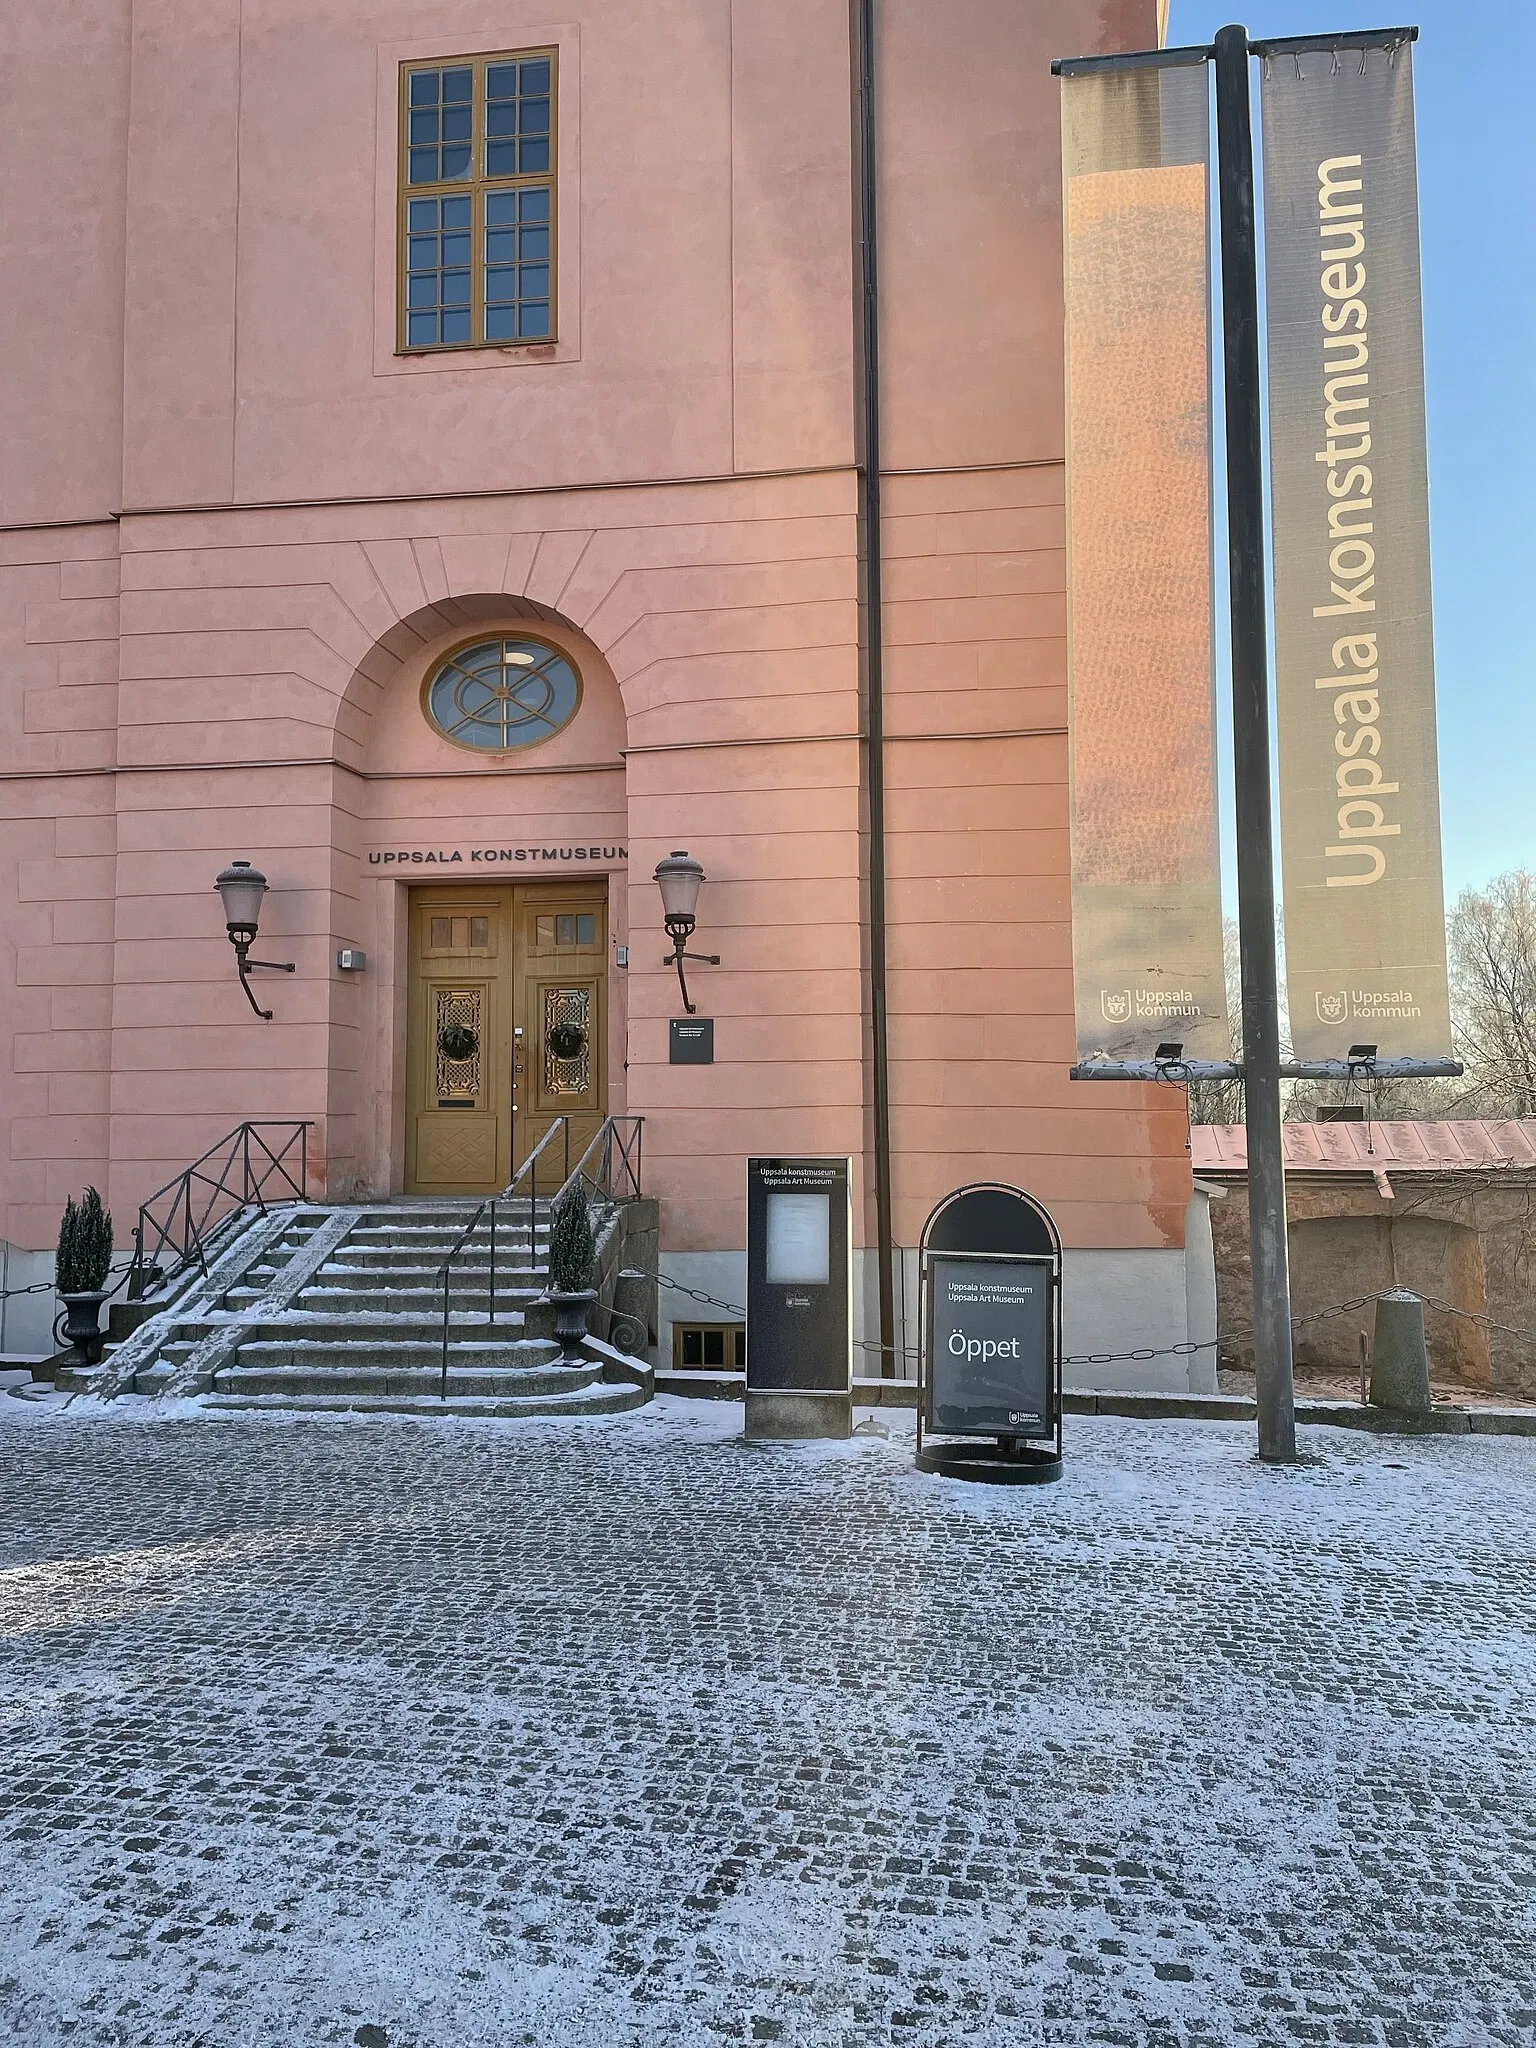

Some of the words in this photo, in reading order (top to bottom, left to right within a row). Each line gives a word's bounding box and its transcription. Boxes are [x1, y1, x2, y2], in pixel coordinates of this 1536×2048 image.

[1313, 154, 1377, 618] konstmuseum
[1315, 631, 1402, 888] Uppsala
[368, 850, 463, 864] UPPSALA
[1135, 989, 1193, 1004] Uppsala
[1351, 990, 1413, 1004] Uppsala
[1136, 1002, 1201, 1017] kommun
[1352, 1004, 1421, 1018] kommun
[760, 1168, 788, 1176] Uppsala
[788, 1168, 836, 1176] konstmuseum
[764, 1177, 791, 1186] Uppsala
[948, 1282, 978, 1292] Uppsala
[979, 1283, 1033, 1294] konstmuseum
[948, 1293, 978, 1302] Uppsala
[979, 1294, 992, 1303] Art
[992, 1295, 1025, 1304] Museum
[948, 1329, 1020, 1362] Öppet
